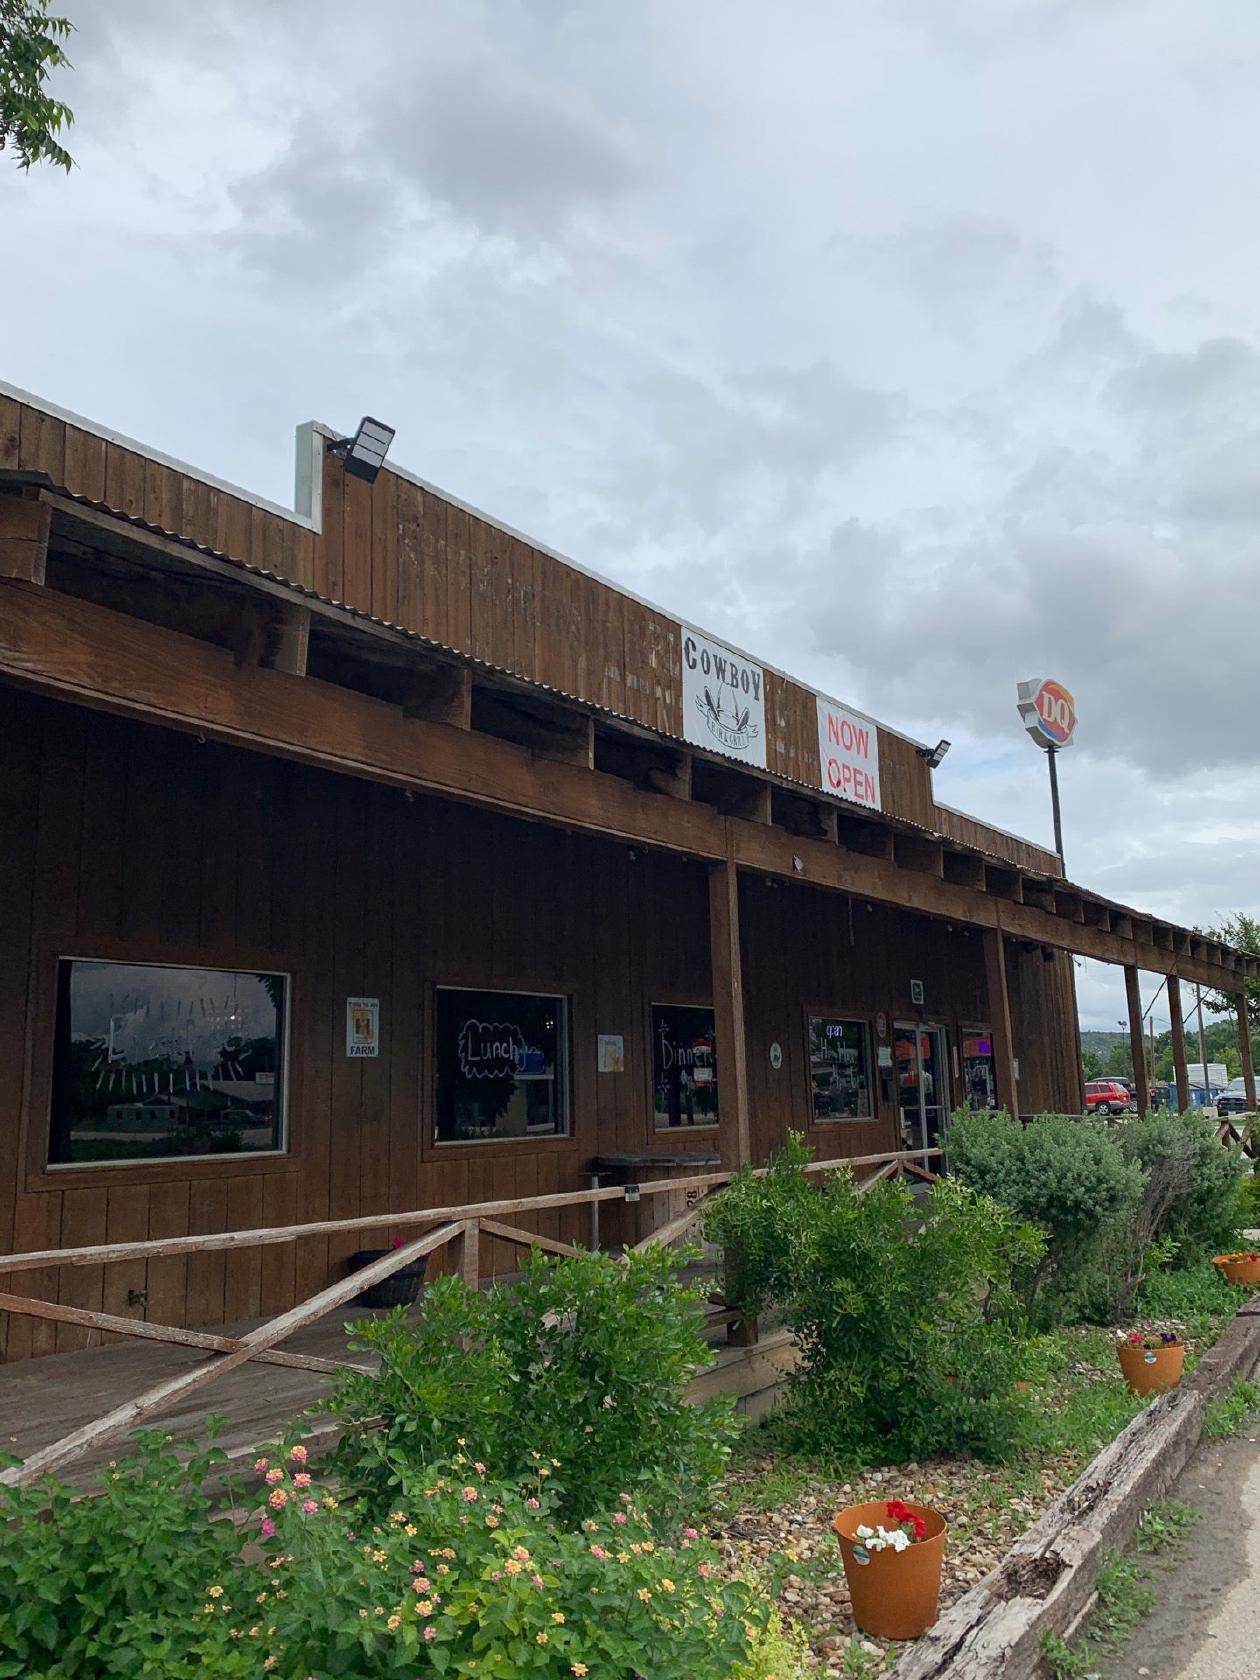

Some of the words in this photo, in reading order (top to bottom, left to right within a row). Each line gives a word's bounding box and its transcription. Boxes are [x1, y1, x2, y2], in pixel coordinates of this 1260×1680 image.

[684, 637, 760, 701] COWBOY
[1042, 691, 1069, 733] DQ
[828, 712, 869, 759] NOW
[828, 758, 876, 804] OPEN
[350, 1045, 375, 1055] FARM
[468, 1031, 519, 1065] Lunch
